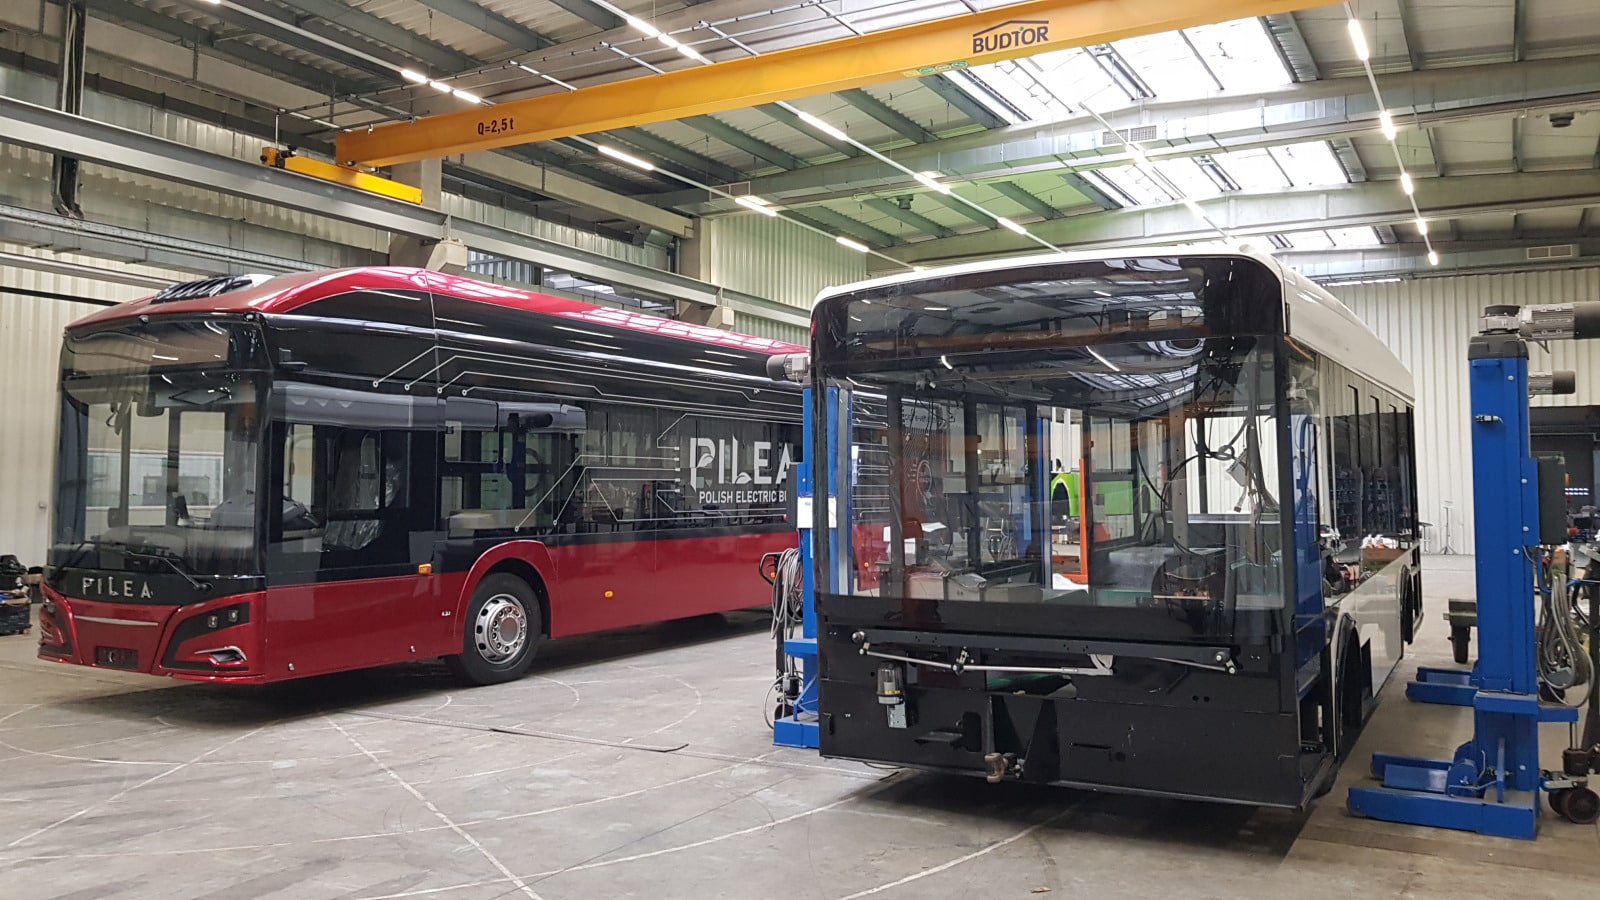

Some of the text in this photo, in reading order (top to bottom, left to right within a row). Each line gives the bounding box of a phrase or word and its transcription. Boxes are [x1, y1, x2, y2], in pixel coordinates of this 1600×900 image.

[973, 26, 1048, 54] BUDTOR
[477, 117, 514, 136] Q=2,5 t
[689, 434, 791, 493] PILEA
[699, 490, 733, 504] POLISH
[735, 490, 777, 503] ELECTRIC
[82, 576, 152, 599] PILEA
